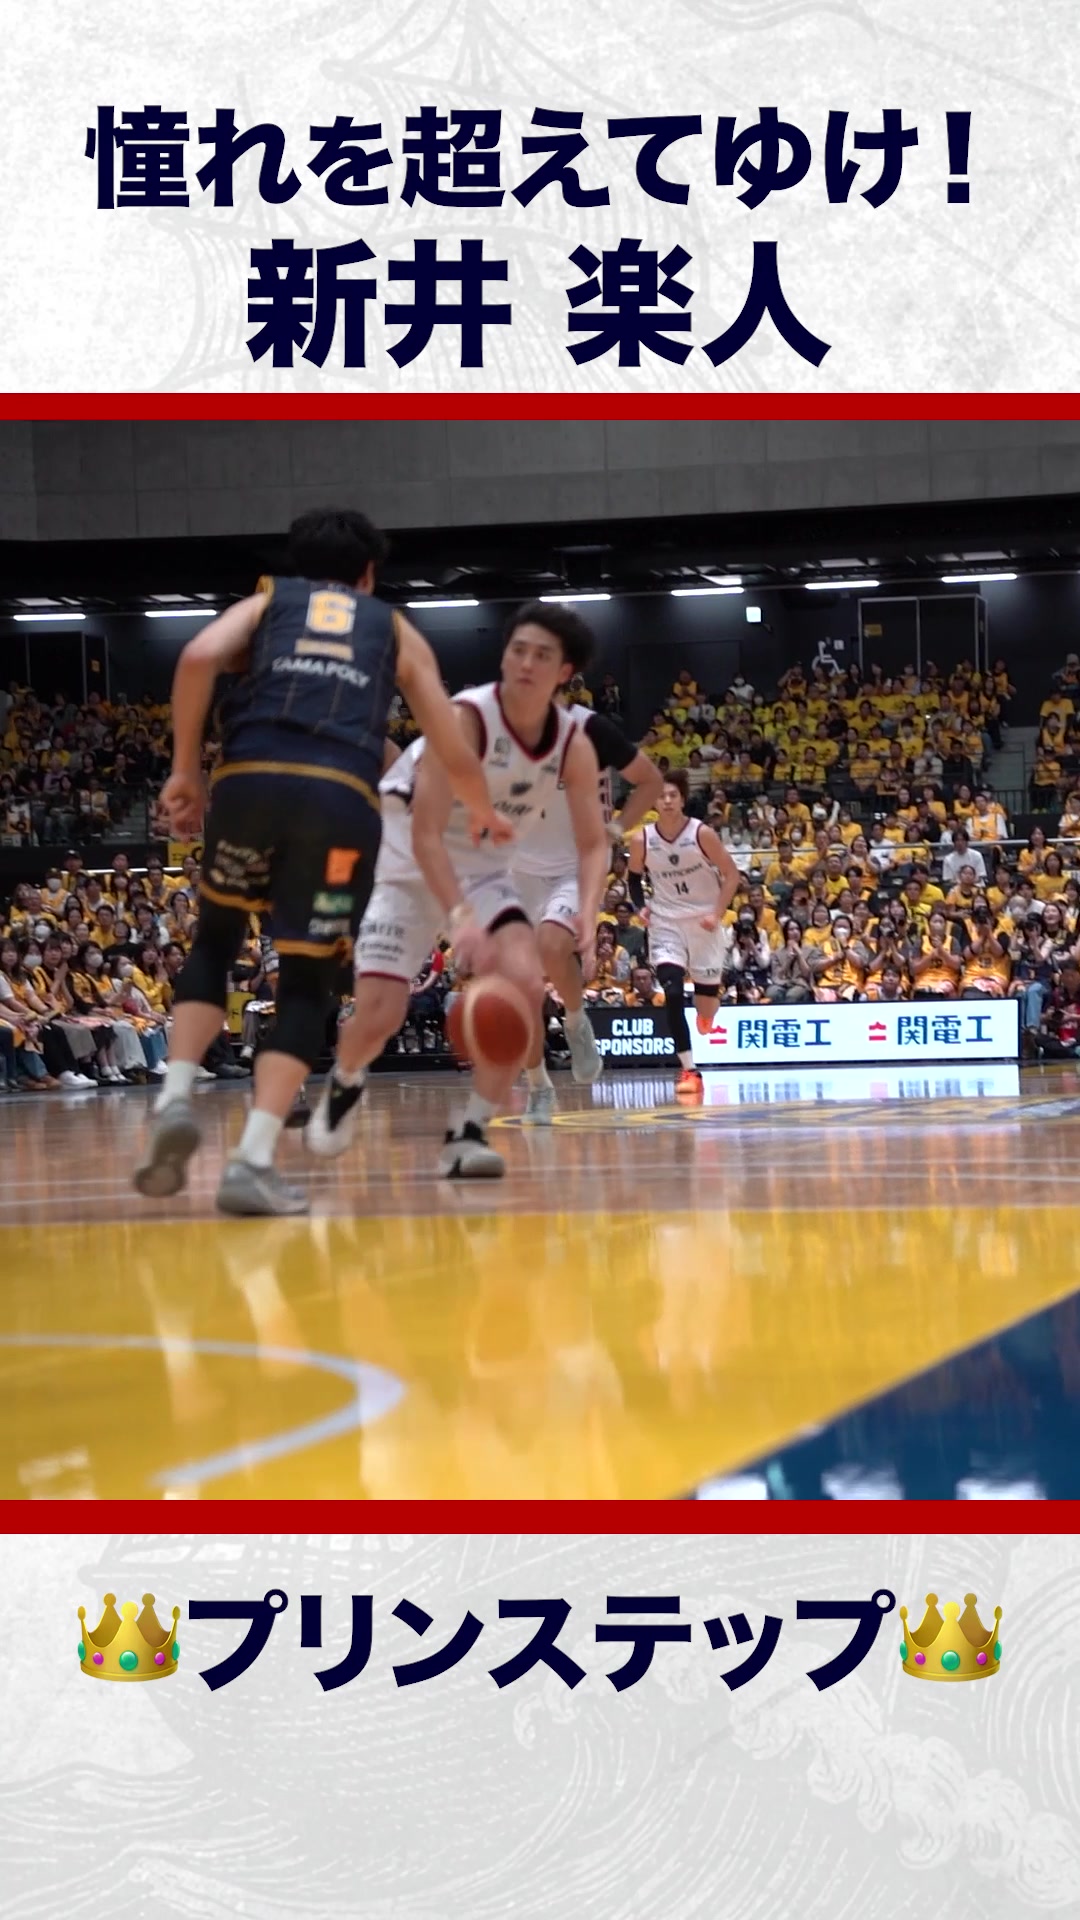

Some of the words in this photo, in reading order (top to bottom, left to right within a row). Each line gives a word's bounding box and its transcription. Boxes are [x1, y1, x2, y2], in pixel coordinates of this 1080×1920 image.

[306, 589, 357, 635] 6
[675, 881, 689, 895] 14
[611, 1018, 654, 1036] CLUB
[738, 1019, 832, 1049] 関電工
[897, 1015, 993, 1045] 関電工
